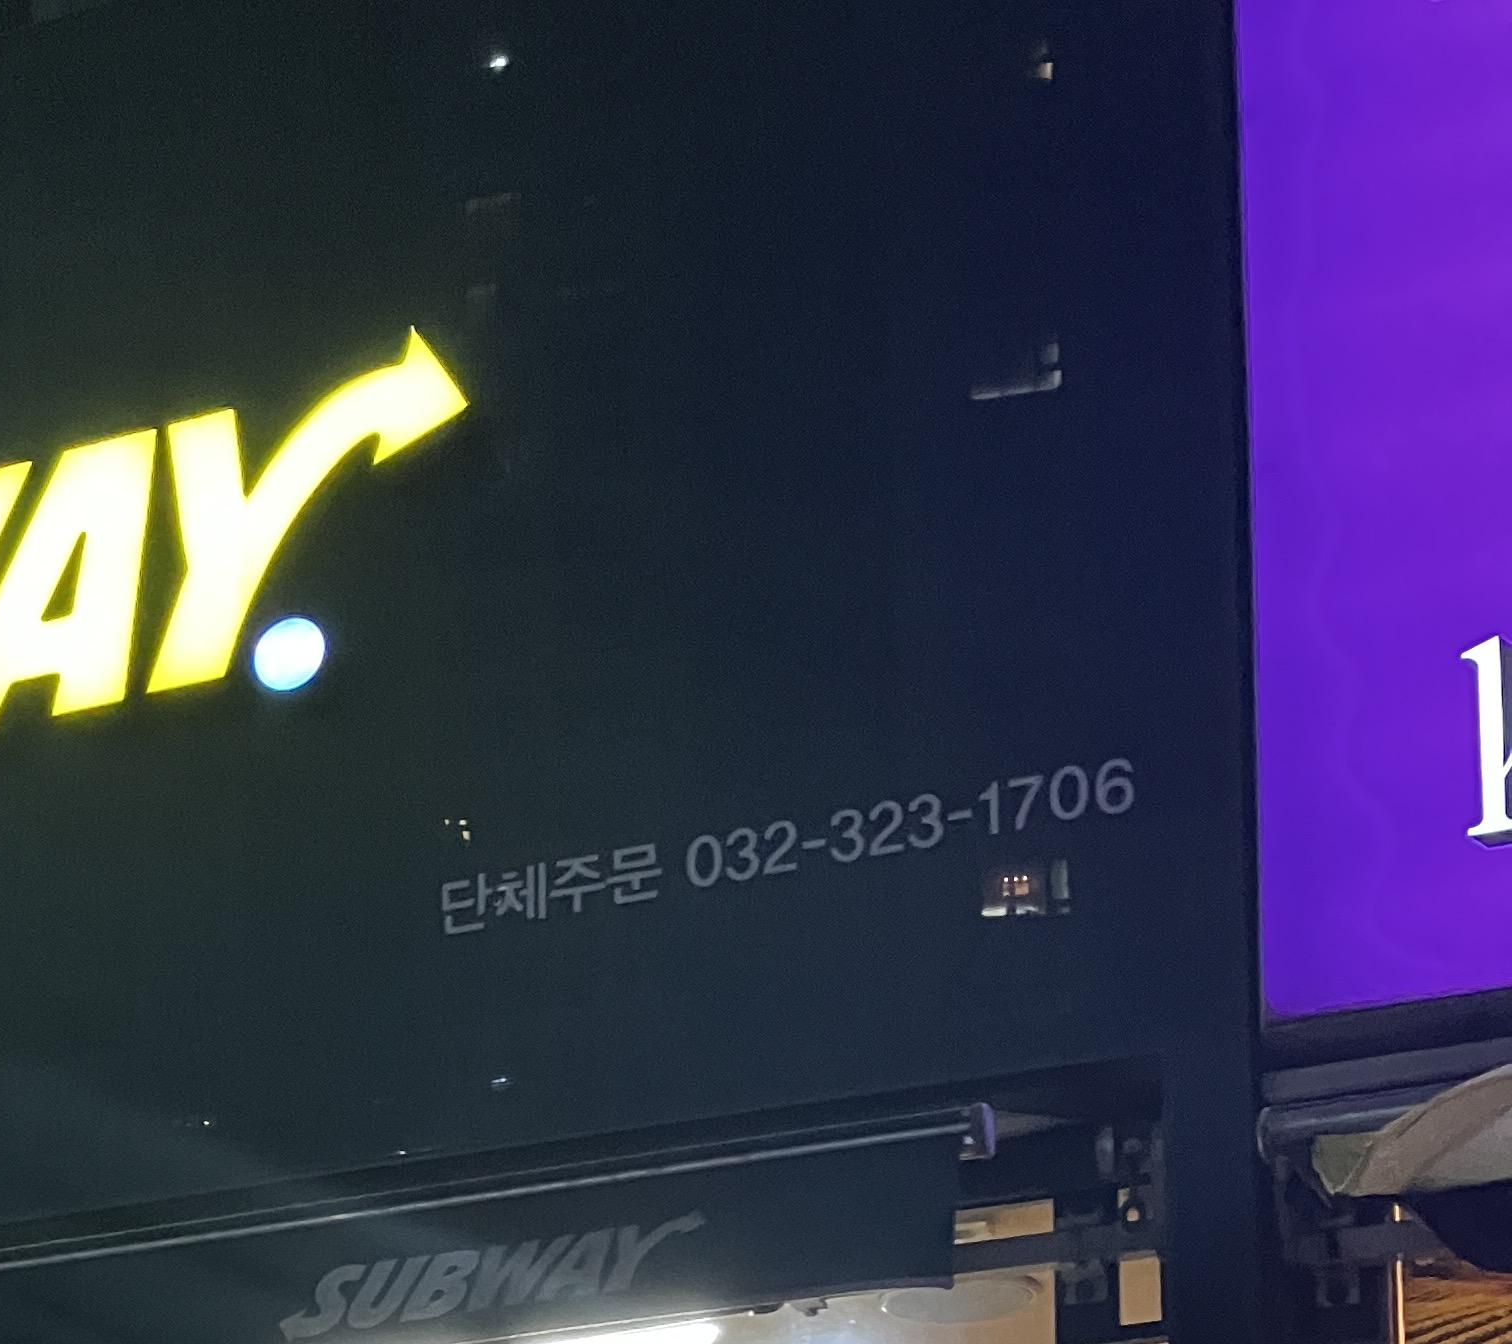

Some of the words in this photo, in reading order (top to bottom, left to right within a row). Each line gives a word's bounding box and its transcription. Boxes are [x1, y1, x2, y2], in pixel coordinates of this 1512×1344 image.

[440, 841, 665, 936] 단체주문
[685, 756, 1137, 890] 032-323-1706
[279, 1213, 707, 1341] SUBWAY
